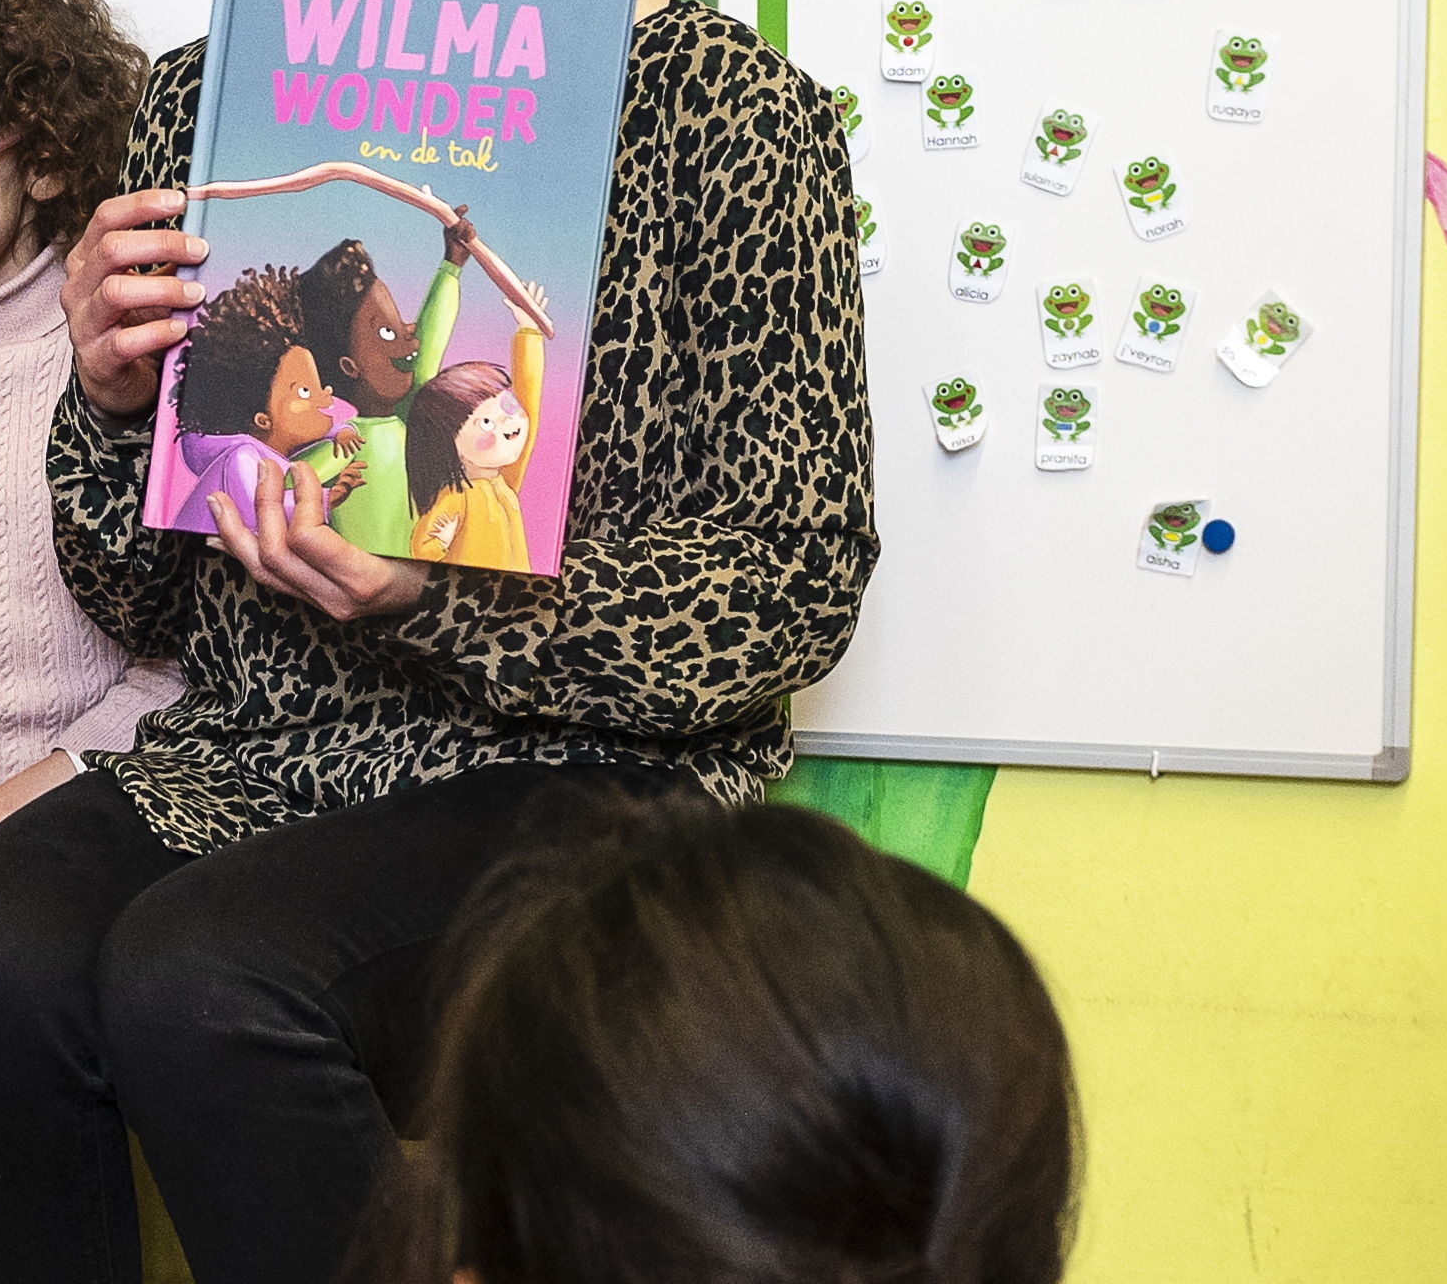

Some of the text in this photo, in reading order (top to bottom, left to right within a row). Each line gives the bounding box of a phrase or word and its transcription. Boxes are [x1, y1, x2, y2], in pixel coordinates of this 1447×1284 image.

[887, 65, 926, 77] adam
[272, 69, 537, 144] WONDER
[926, 133, 978, 147] Hannah
[359, 126, 499, 173] en de tak
[1145, 217, 1184, 239] norah
[955, 286, 989, 301] alicia
[1051, 348, 1100, 365] zaynab
[1041, 451, 1088, 466] pranita
[1146, 554, 1181, 570] aisha
